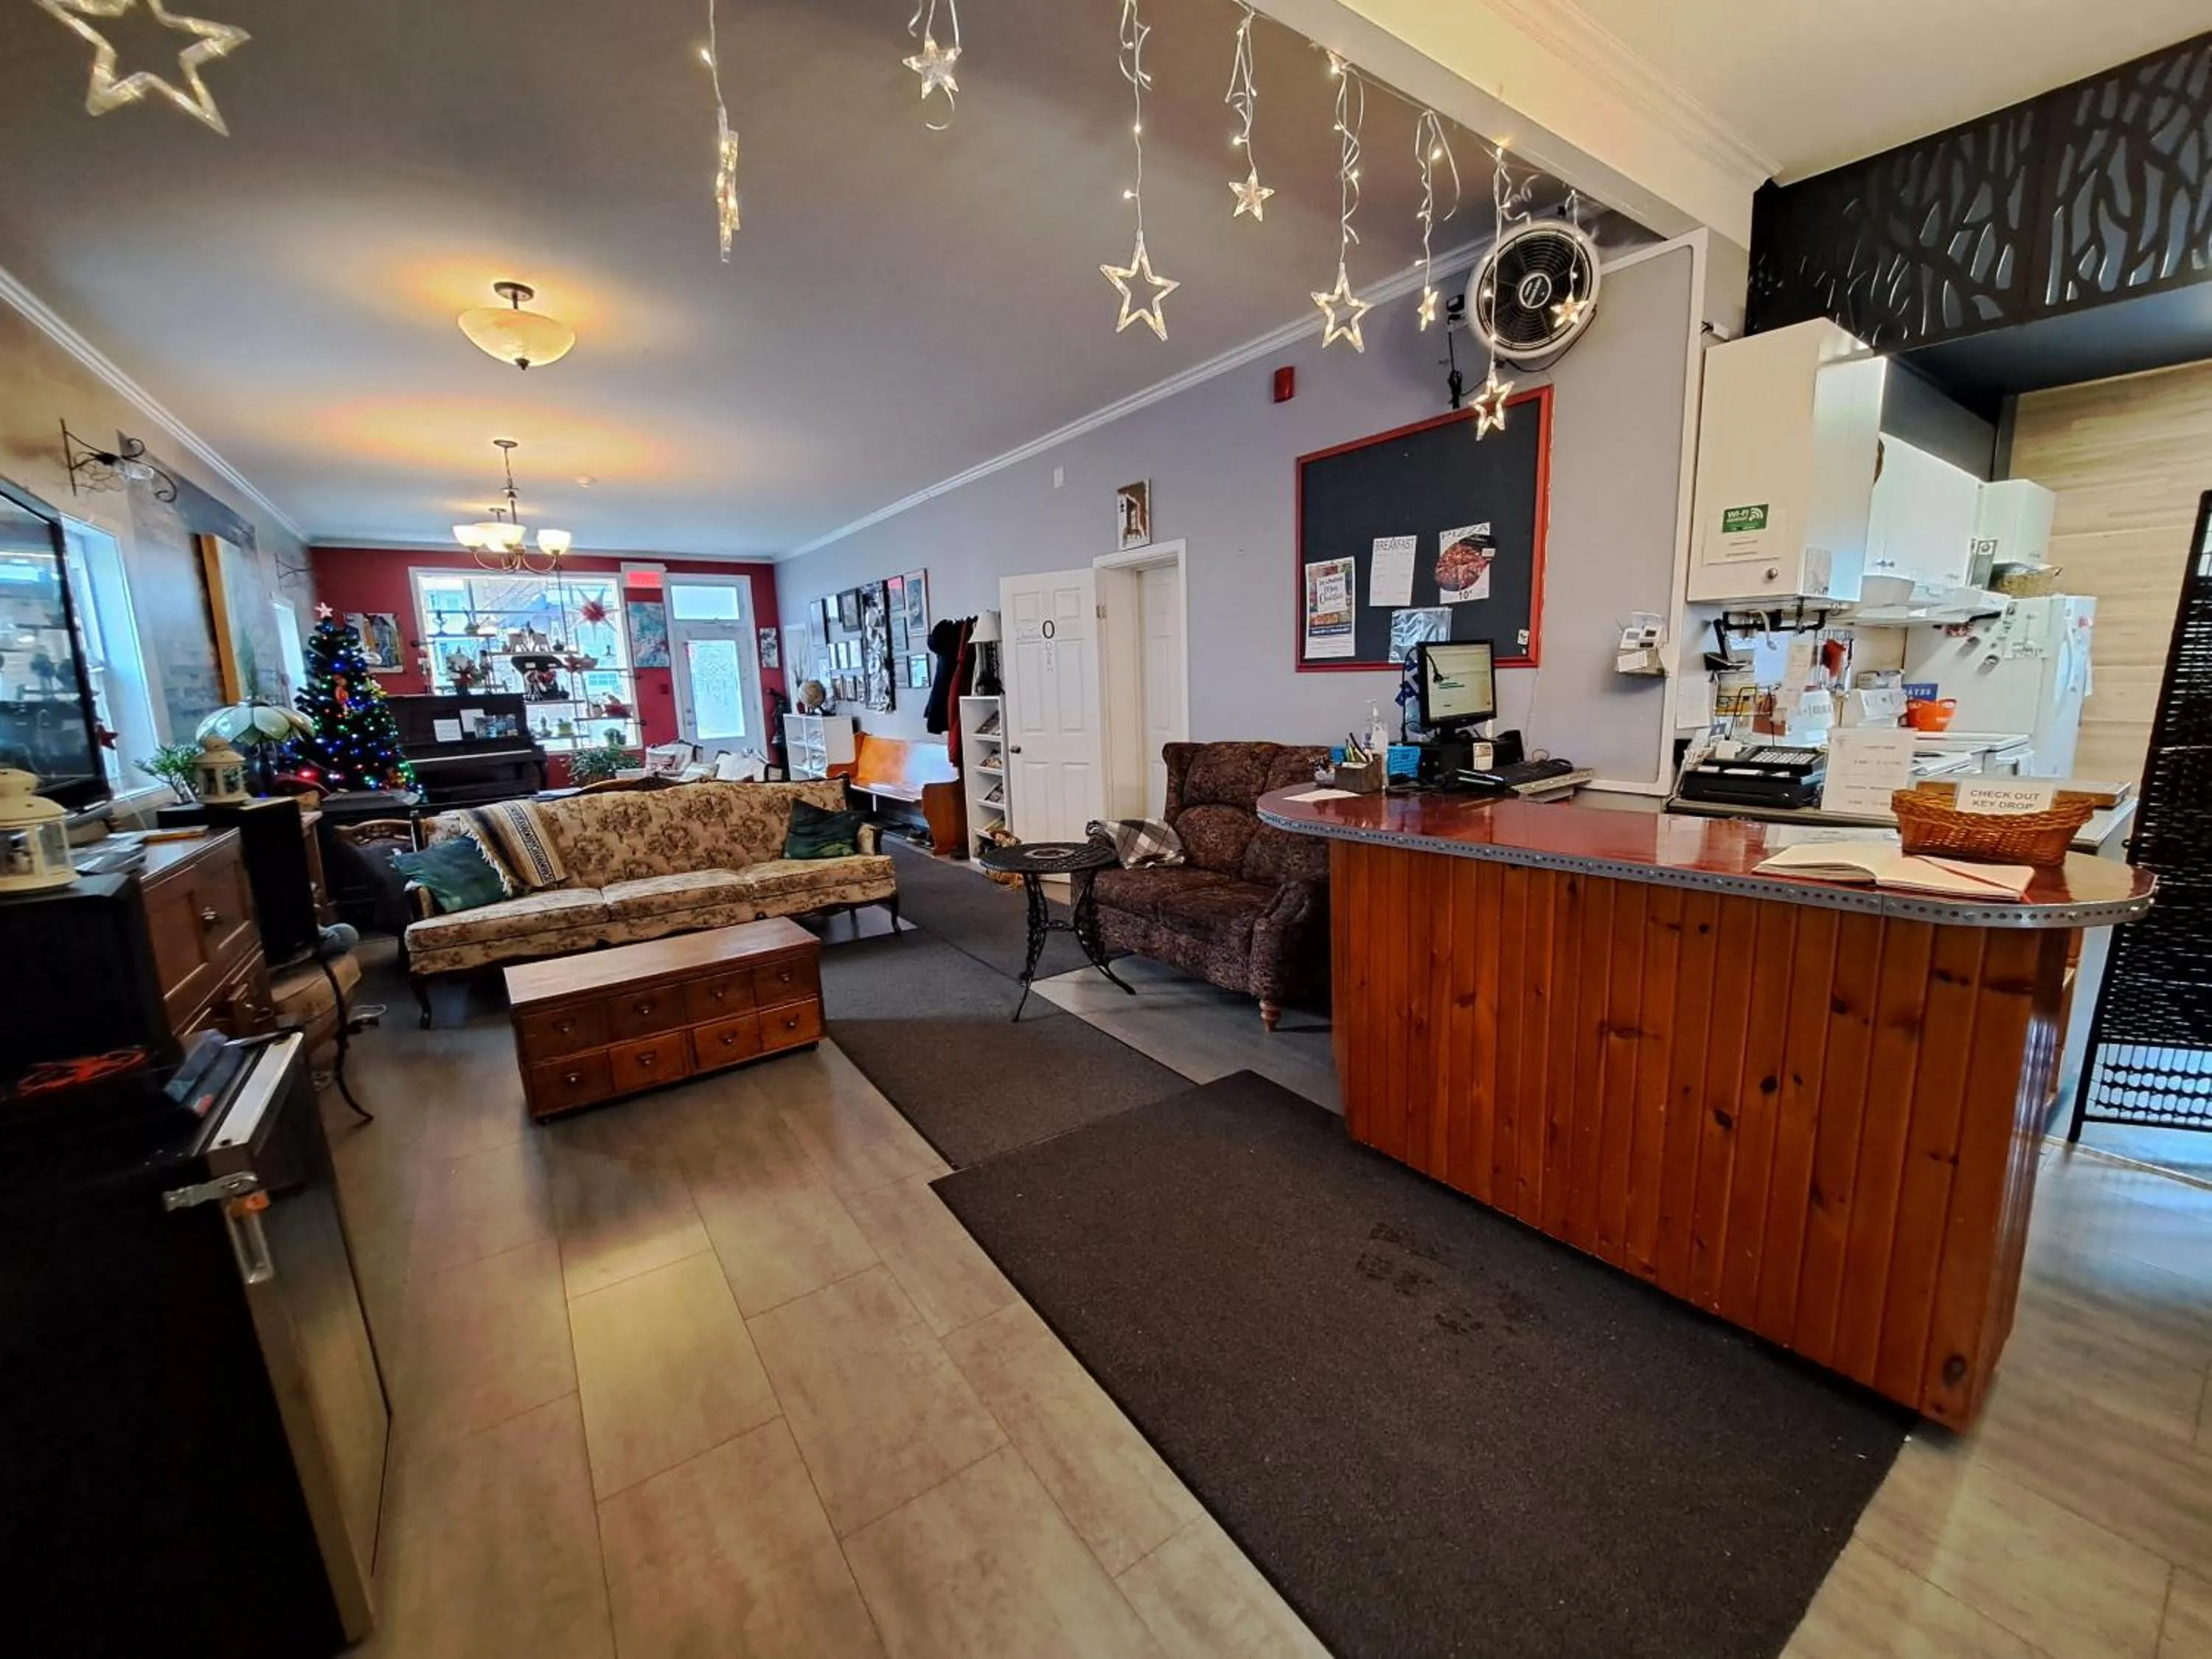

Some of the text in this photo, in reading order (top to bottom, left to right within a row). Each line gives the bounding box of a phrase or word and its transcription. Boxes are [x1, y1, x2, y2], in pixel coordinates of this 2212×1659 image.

[1441, 524, 1489, 540] PIZZA
[1374, 538, 1415, 552] BREAKFAST
[1969, 790, 2041, 800] CHECK OUT
[1972, 800, 2036, 810] KEY DROP
